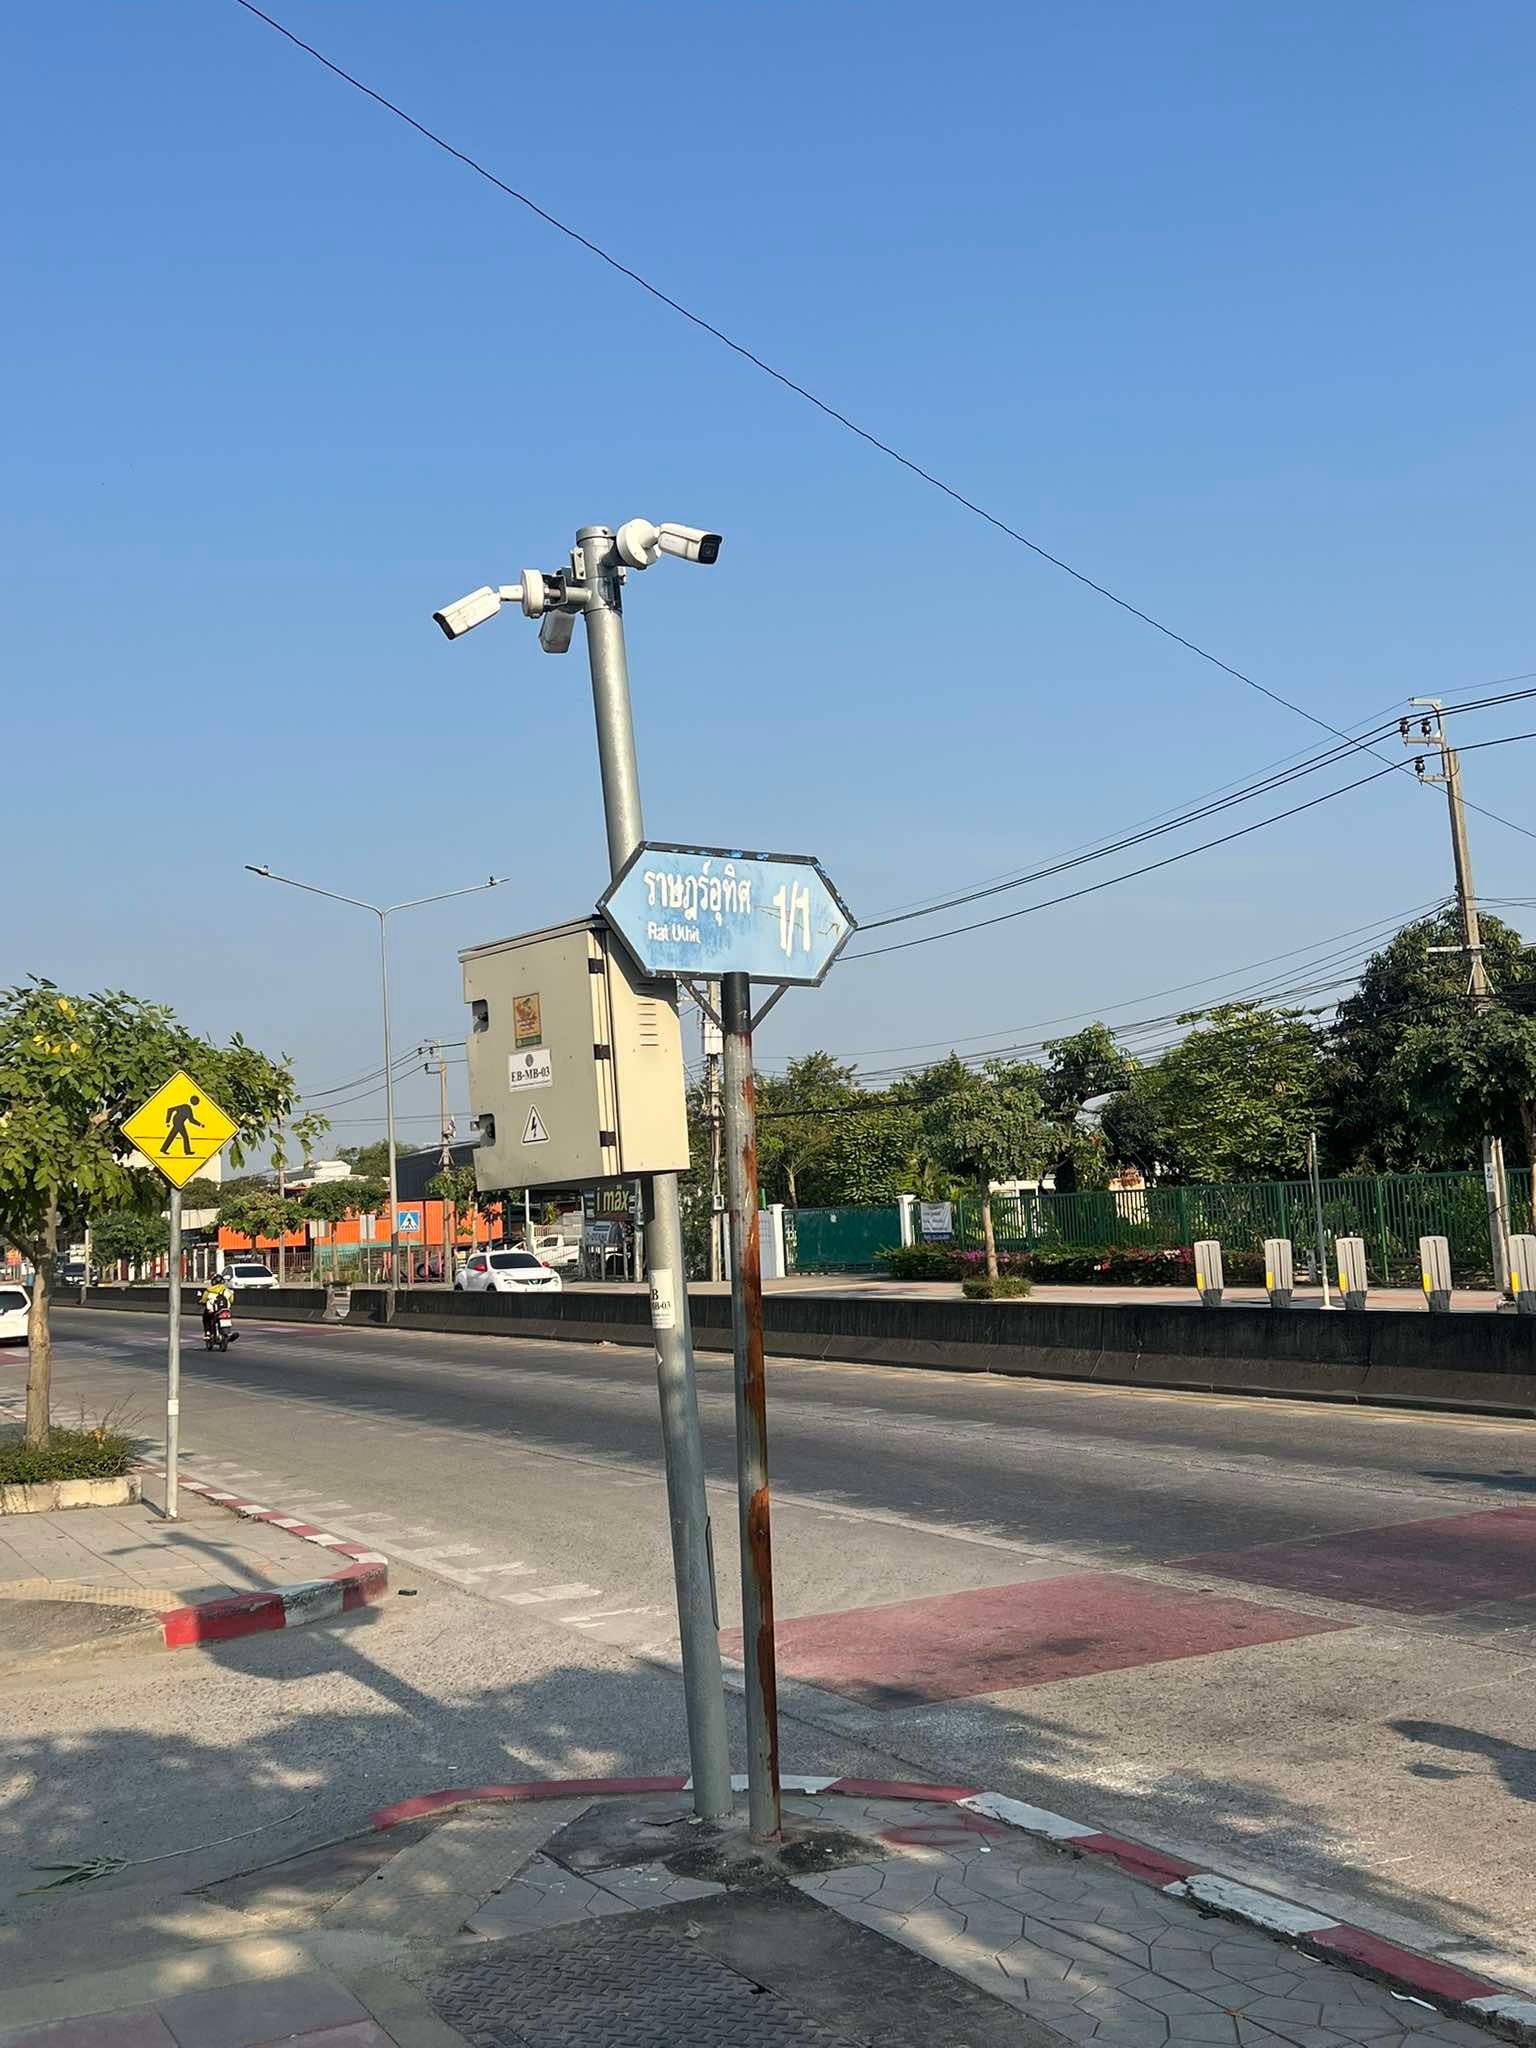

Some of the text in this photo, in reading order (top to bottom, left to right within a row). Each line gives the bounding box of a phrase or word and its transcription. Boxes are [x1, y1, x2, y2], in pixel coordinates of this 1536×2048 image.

[644, 860, 811, 956] ราษฎร์อุทิศ 1/1
[648, 920, 670, 941] Rat
[511, 1066, 550, 1082] EB-MB-03
